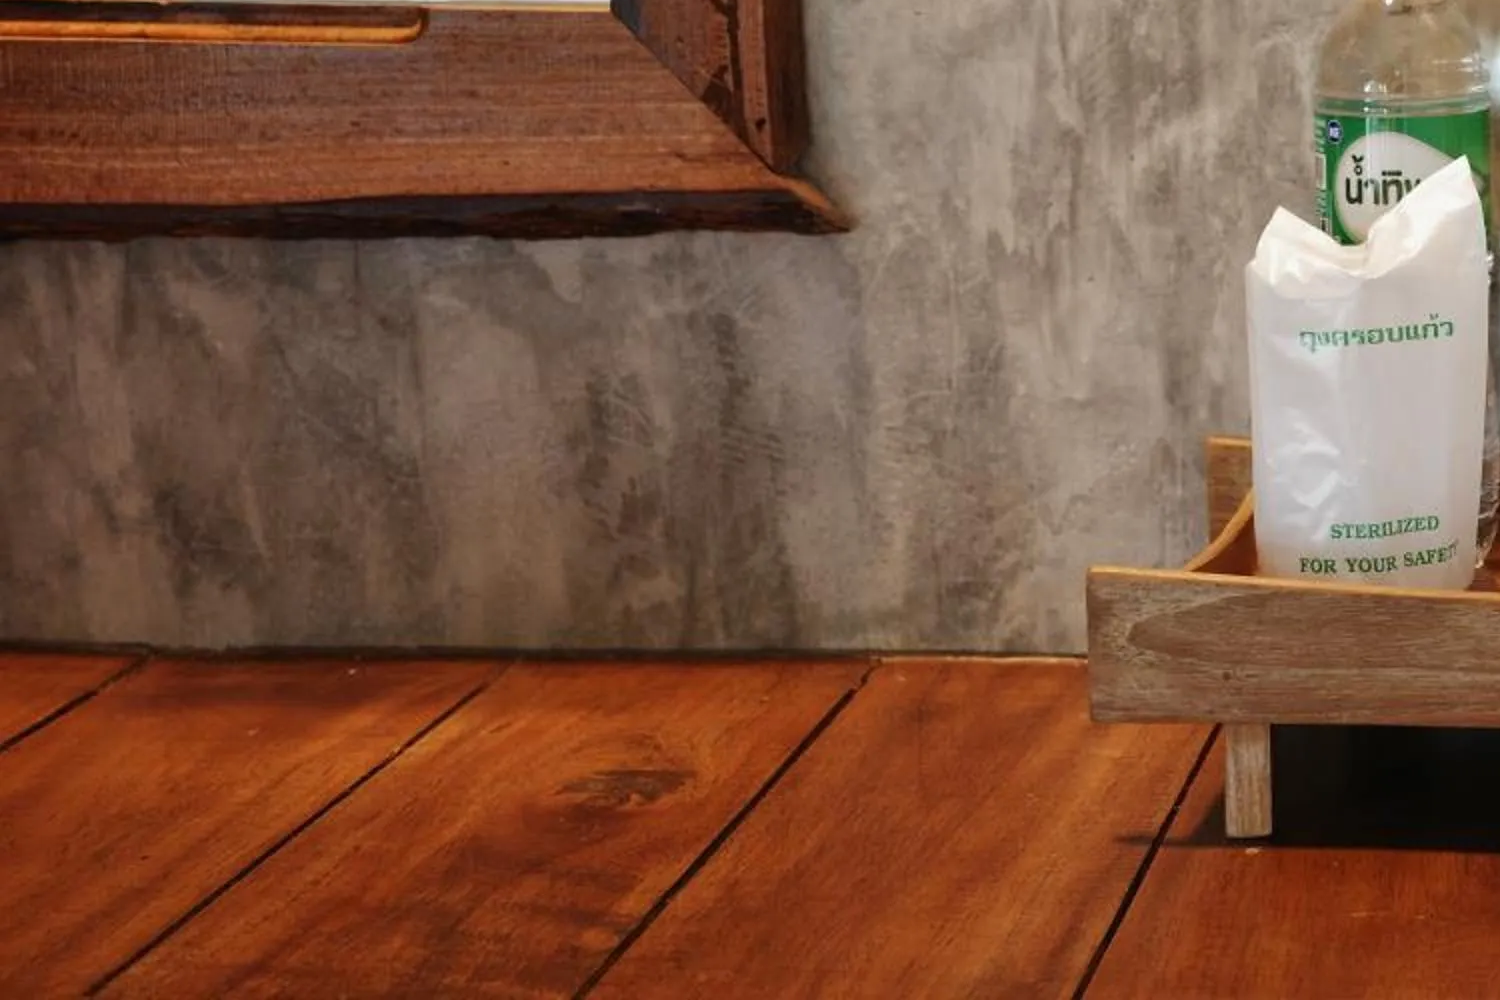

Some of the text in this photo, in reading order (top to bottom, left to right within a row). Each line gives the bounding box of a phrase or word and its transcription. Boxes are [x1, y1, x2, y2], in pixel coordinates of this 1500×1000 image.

[1330, 515, 1439, 539] STERILIZED
[1300, 557, 1337, 574] FOR
[1345, 556, 1398, 573] YOUR
